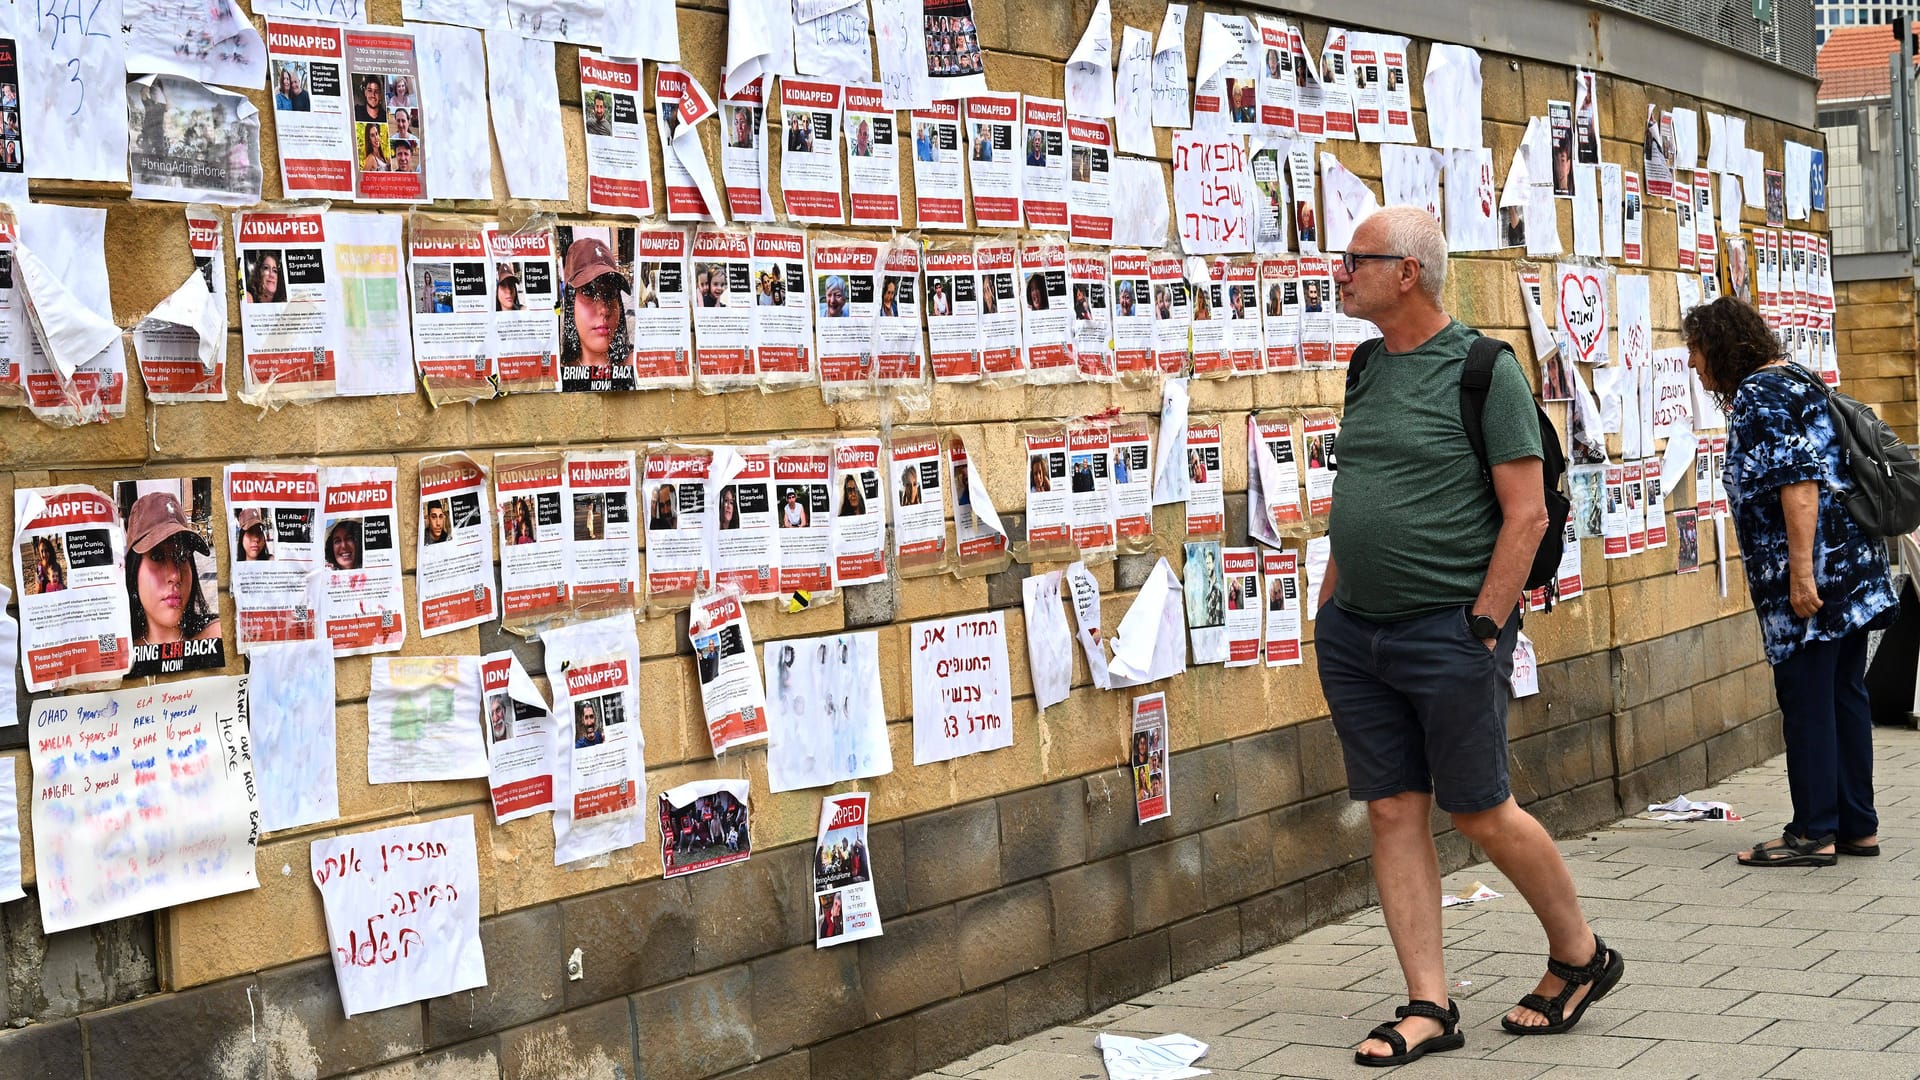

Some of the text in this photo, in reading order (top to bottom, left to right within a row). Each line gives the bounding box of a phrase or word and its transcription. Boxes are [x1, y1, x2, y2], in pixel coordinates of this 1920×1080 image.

[269, 33, 337, 52] KIDNAPPED
[0, 51, 12, 62] ZA
[786, 88, 833, 104] KIDNAPPED
[848, 94, 884, 110] KIDNAPP
[970, 101, 1011, 116] KIDNAPPED
[1028, 108, 1061, 124] KIDNAPPED
[1812, 161, 1824, 197] 35
[243, 221, 320, 236] KIDNAPPED
[492, 236, 546, 250] KIDNAPPED
[926, 252, 972, 266] KIDNAPPED
[563, 366, 590, 381] BRING
[612, 365, 633, 379] BACK
[590, 380, 612, 392] NOW!
[422, 467, 478, 490] IDNAPPED
[502, 467, 559, 485] KIDNAPPED
[572, 466, 628, 482] KIDNAPPED
[232, 479, 318, 496] KIDNAPPED
[36, 500, 107, 518] NAPPED
[288, 513, 307, 521] Alba
[68, 534, 87, 543] Sharon
[707, 602, 737, 621] APPED
[920, 619, 998, 652] תחזירו את
[133, 636, 218, 662] RING LIRI BACK
[161, 657, 184, 674] NOW!
[936, 656, 991, 679] החטופים
[568, 667, 623, 689] KIDNAPPED
[941, 683, 982, 704] עכשיו
[136, 696, 153, 710] ELA
[37, 708, 68, 729] OHAD
[132, 734, 158, 752] SAHAR
[219, 716, 239, 774] HOME
[41, 782, 76, 802] ABIGAIL
[828, 804, 863, 827] APPED
